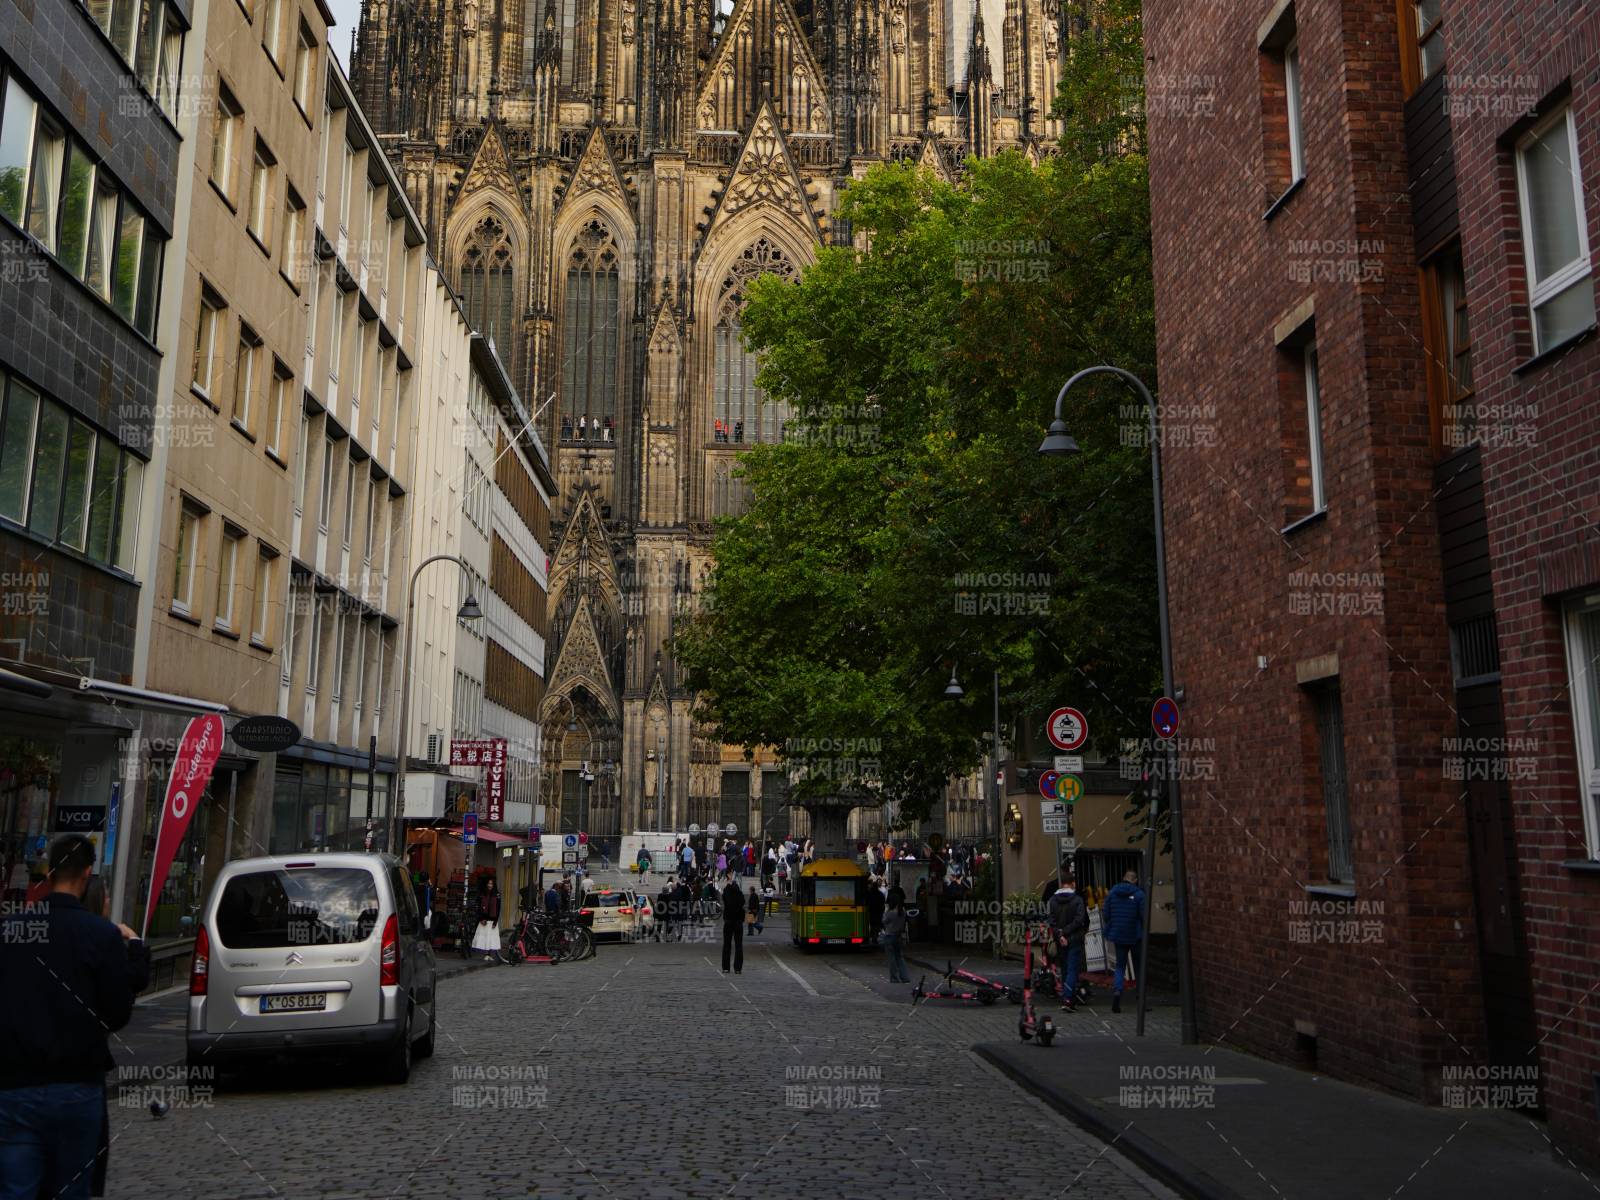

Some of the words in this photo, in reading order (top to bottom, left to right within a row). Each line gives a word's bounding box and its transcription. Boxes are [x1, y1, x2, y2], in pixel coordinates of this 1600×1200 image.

[184, 721, 213, 788] vodafone
[452, 750, 492, 762] 免税店
[490, 751, 503, 820] SOUVENIRS
[1064, 781, 1075, 798] H
[59, 810, 92, 824] Lyca
[267, 996, 274, 1008] K
[298, 994, 325, 1007] 8112
